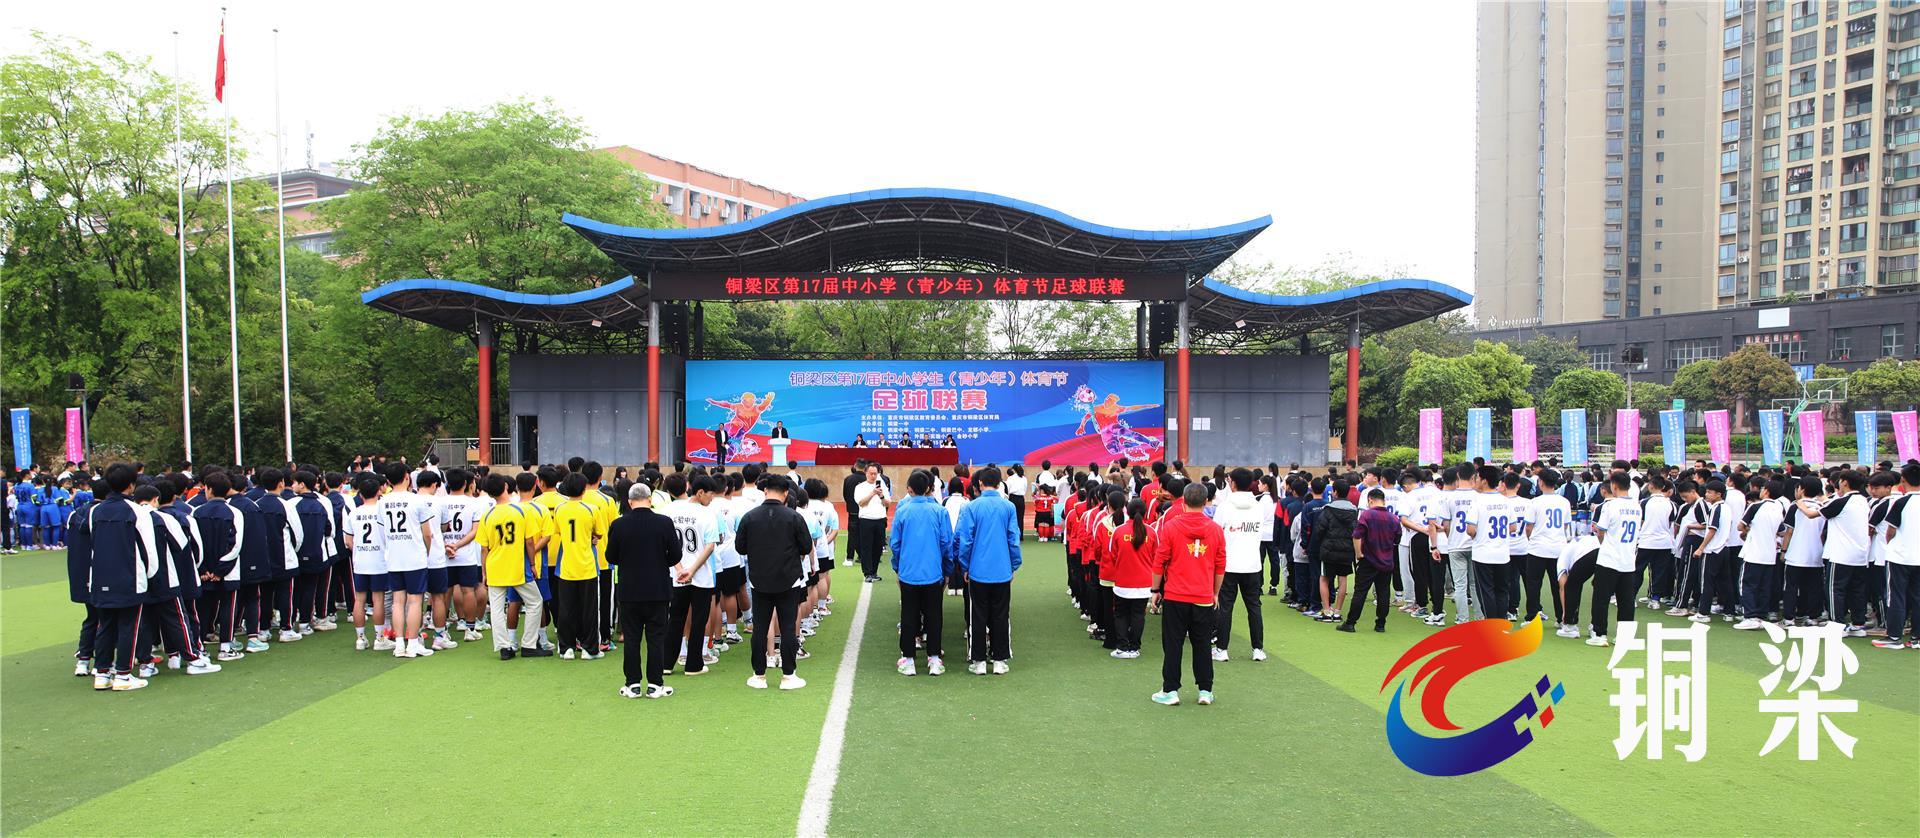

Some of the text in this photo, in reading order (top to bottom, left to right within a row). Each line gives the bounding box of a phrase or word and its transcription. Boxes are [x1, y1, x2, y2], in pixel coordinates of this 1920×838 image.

[725, 277, 1125, 295] 铜梁区第17届中小学（青少年）体育节足球联赛
[789, 371, 1069, 387] 铜梁区第17届中小学生（青少年）体育节
[872, 389, 988, 411] 足球联赛
[386, 510, 407, 533] 12
[1488, 515, 1508, 539] 38
[1545, 508, 1563, 529] 30
[362, 522, 372, 544] 2
[495, 520, 515, 546] 13
[568, 519, 576, 542] 1
[1620, 520, 1636, 543] 29
